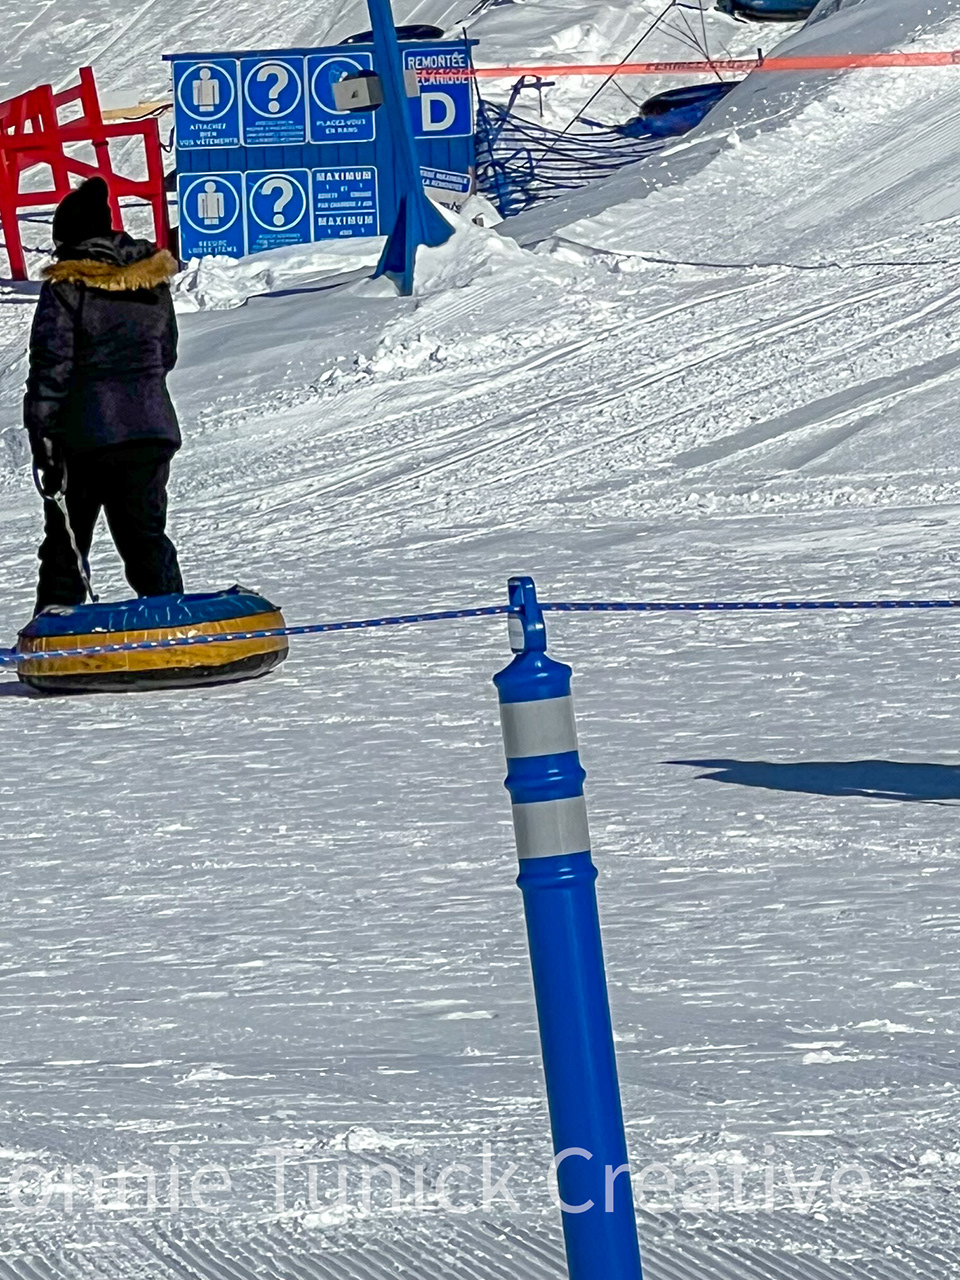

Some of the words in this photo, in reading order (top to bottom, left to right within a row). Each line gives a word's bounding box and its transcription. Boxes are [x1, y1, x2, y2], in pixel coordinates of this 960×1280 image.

[407, 51, 466, 69] REMONTÉE
[421, 92, 456, 131] D
[316, 171, 372, 181] MAXIMUM
[318, 215, 374, 226] MAXIMUM
